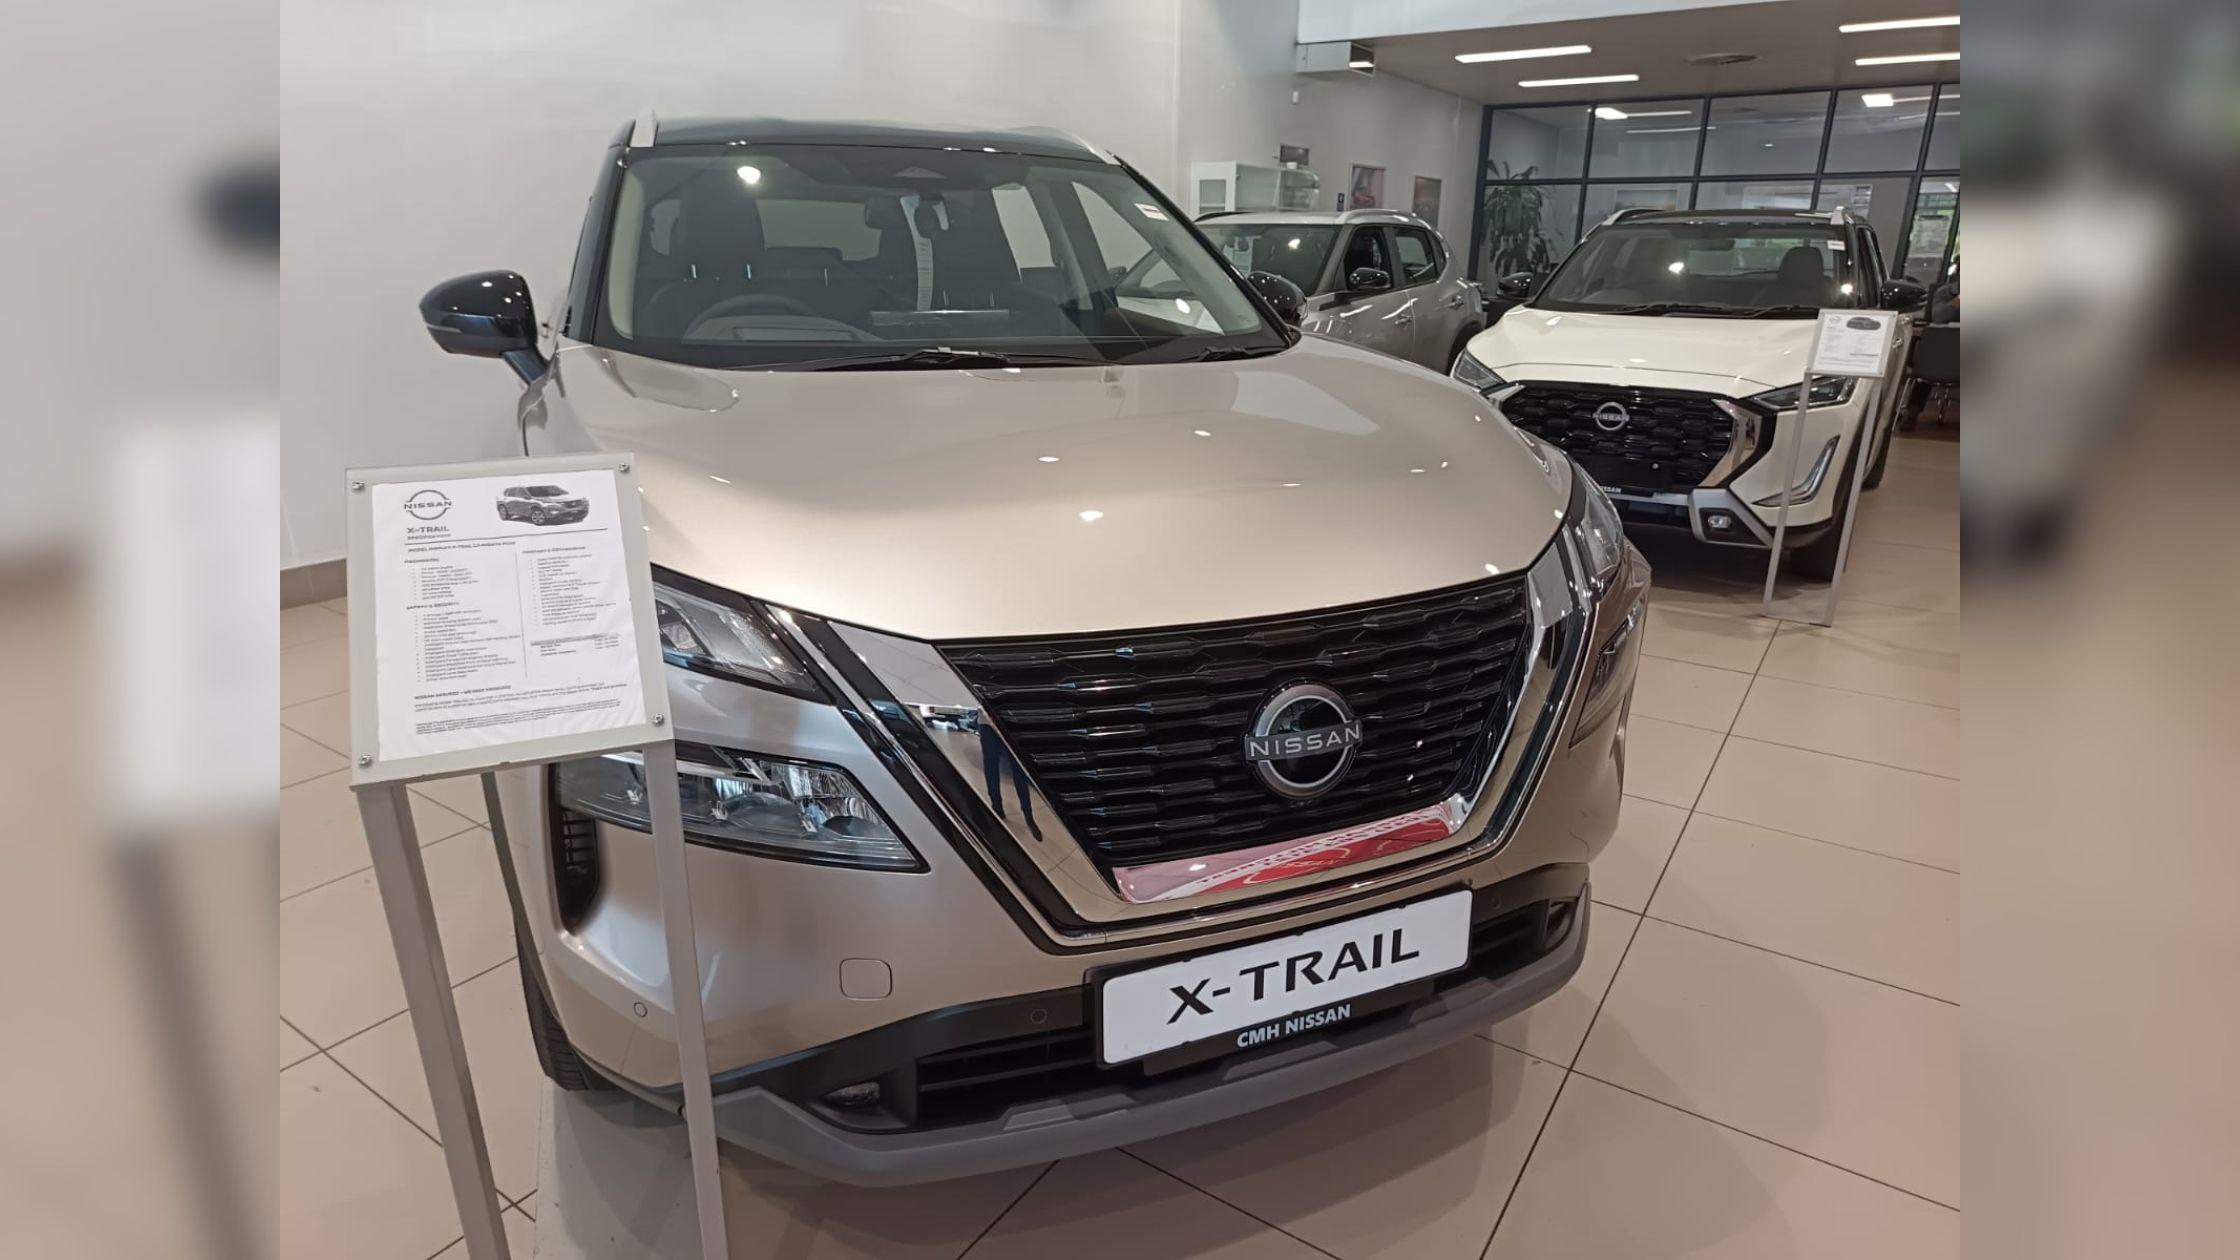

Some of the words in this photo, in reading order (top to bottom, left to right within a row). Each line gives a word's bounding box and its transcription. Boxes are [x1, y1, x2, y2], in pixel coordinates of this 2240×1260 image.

[403, 501, 452, 509] NISSAN
[407, 526, 449, 534] X-TRAIL
[1249, 723, 1360, 757] NISSAN
[1165, 928, 1420, 1025] X-TRAIL
[1236, 1025, 1280, 1048] CMH
[1285, 1003, 1351, 1035] NISSAN
